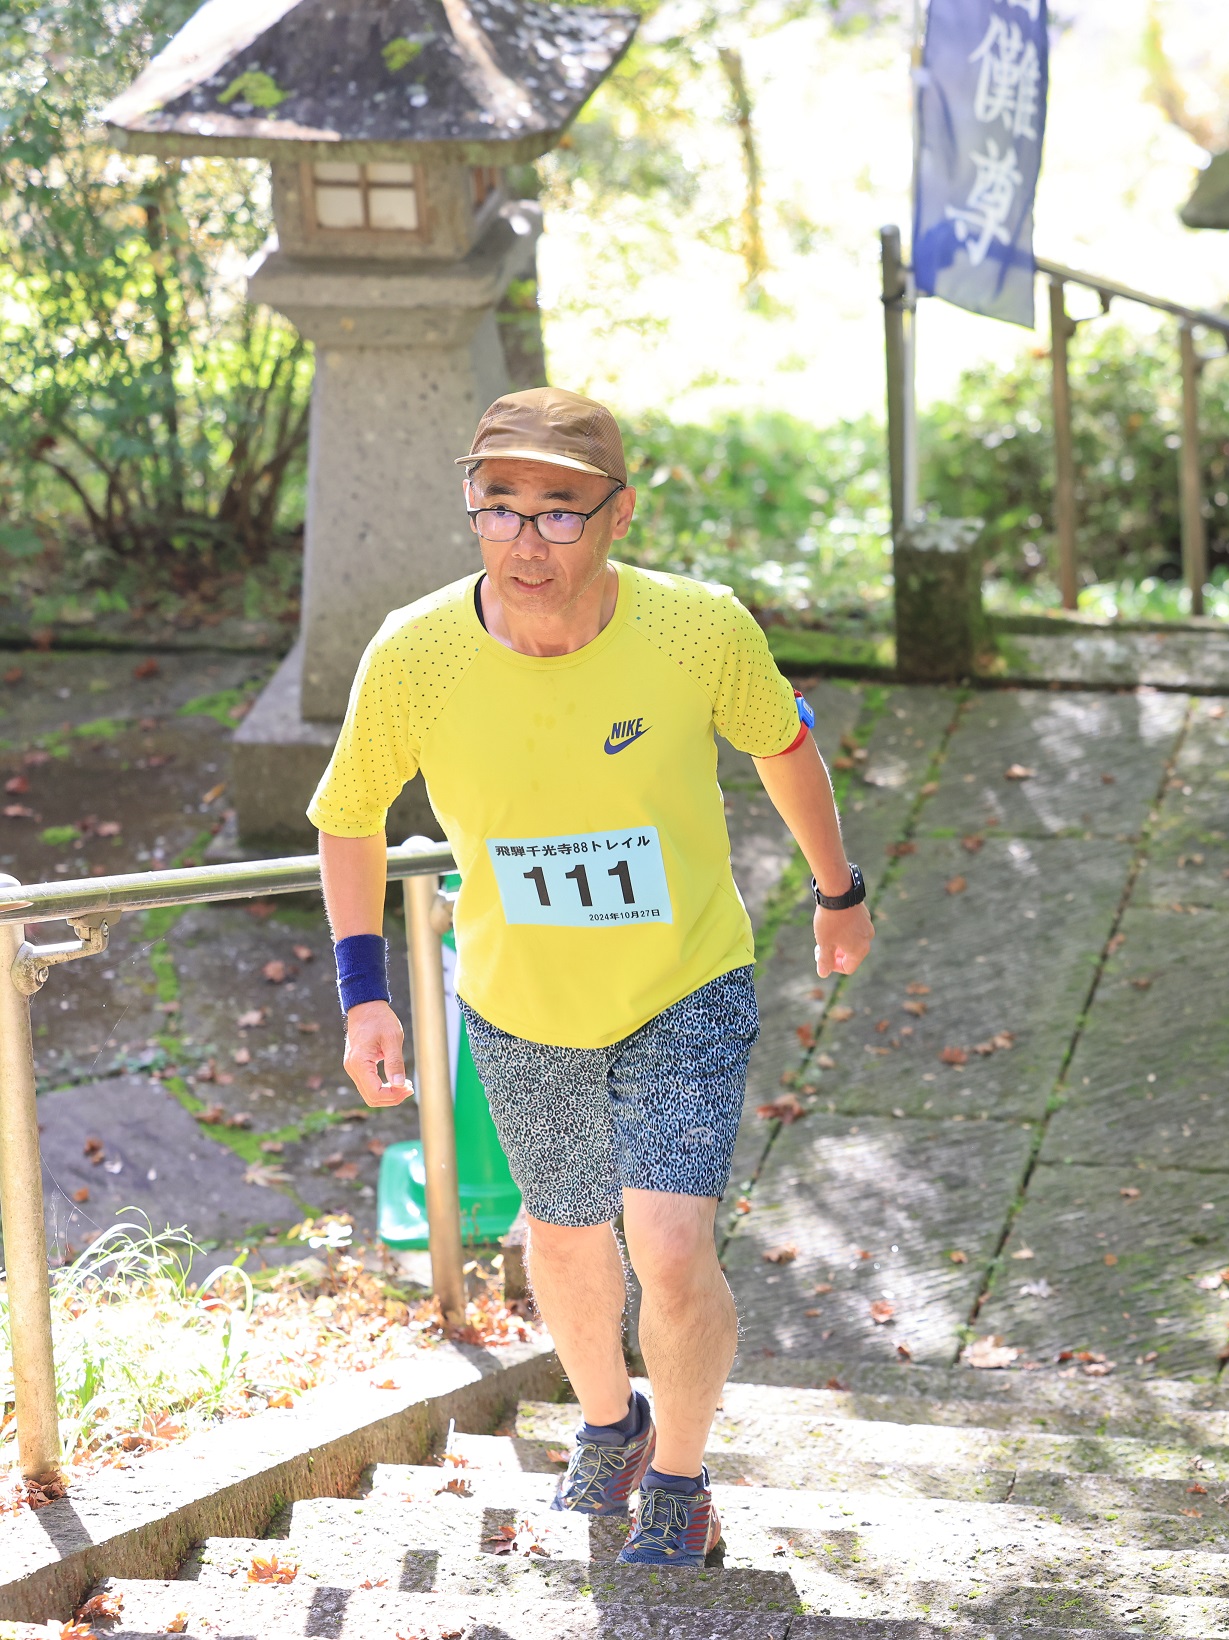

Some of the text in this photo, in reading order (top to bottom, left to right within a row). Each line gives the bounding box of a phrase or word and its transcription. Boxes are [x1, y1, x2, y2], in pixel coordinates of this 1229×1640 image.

[945, 0, 1041, 266] 儺尊
[611, 718, 643, 739] NIKE
[495, 835, 650, 857] 飛騨千光寺88トレイル
[523, 860, 635, 907] 111
[589, 909, 660, 921] 2024年10月27日
